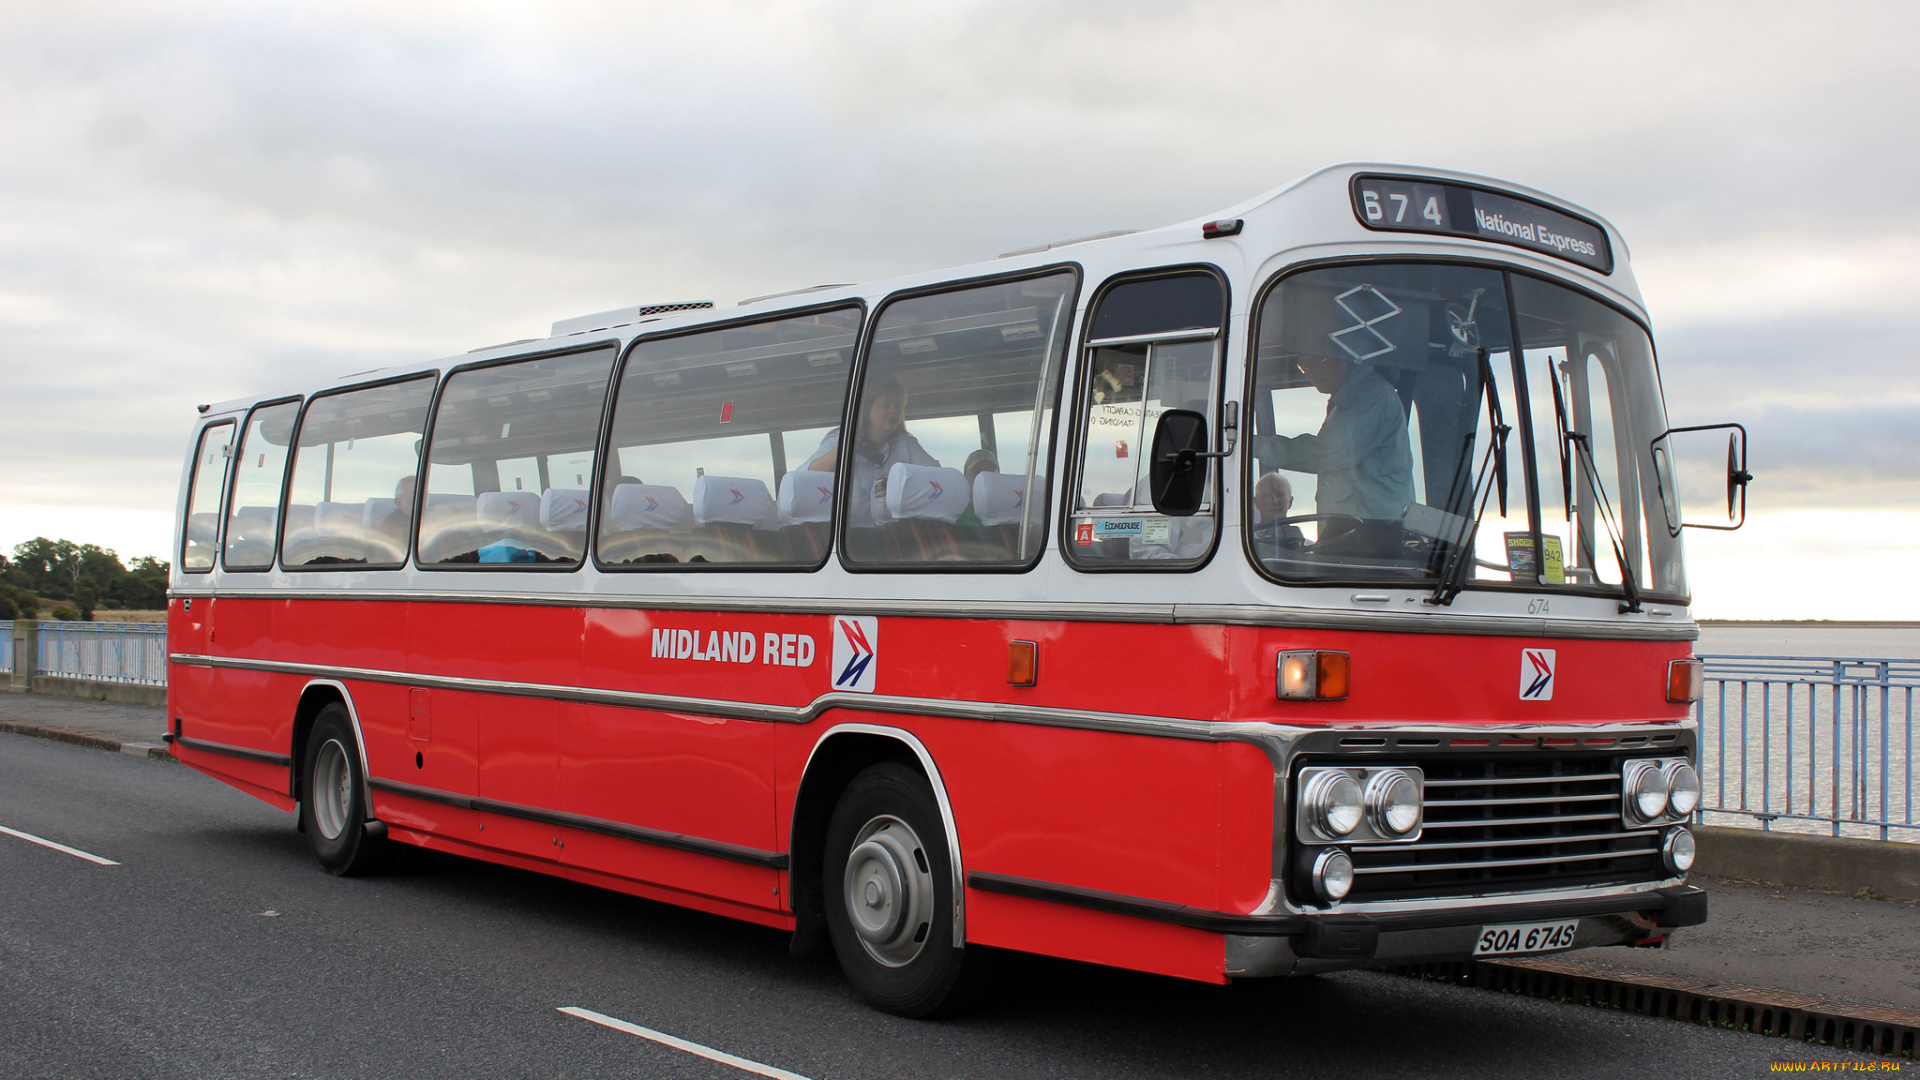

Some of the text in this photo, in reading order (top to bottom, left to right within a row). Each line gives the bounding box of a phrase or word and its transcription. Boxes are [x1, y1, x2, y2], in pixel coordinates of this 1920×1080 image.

[1362, 190, 1441, 225] 674
[1474, 207, 1596, 256] National Express
[1080, 530, 1089, 540] A
[1544, 549, 1561, 562] 942
[1527, 599, 1549, 614] 674
[651, 628, 815, 667] MIDLAND RED
[1480, 925, 1574, 951] SOA 674S
